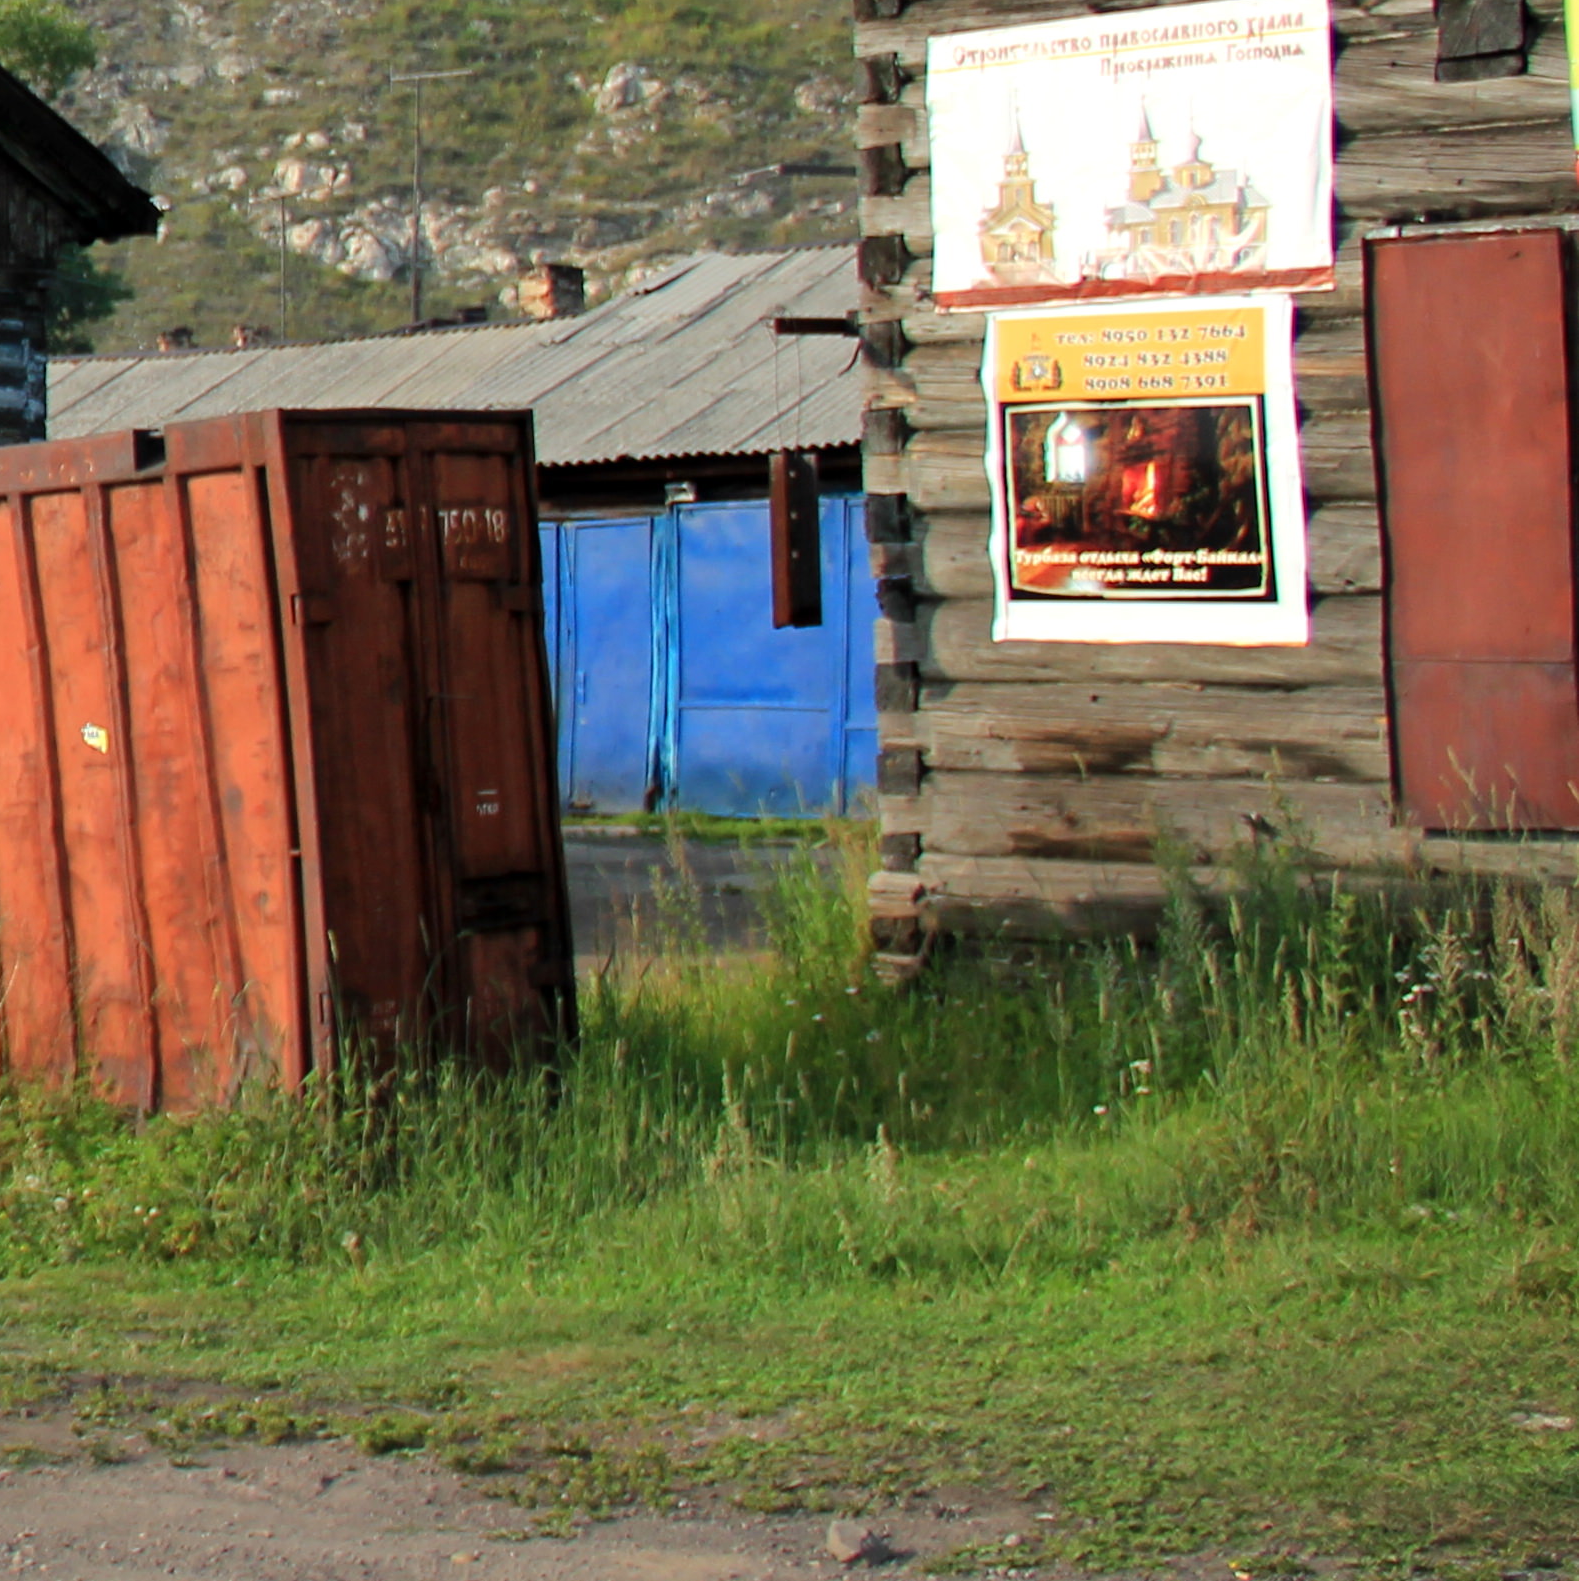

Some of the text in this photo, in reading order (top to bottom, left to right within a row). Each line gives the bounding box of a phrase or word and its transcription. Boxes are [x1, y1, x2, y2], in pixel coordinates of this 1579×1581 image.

[1099, 19, 1238, 57] православного
[1246, 12, 1305, 43] храма
[1227, 43, 1306, 62] Господня
[1101, 328, 1148, 344] 8950
[1156, 326, 1190, 341] 132
[1197, 324, 1246, 341] 7664
[1084, 349, 1228, 368] 8924 832 4388
[1085, 373, 1228, 391] 8908 668 7391
[1015, 548, 1077, 566] Турбаза
[1079, 550, 1139, 566] отдыха
[1072, 567, 1124, 582] всегда
[1173, 566, 1208, 582] Вас!
